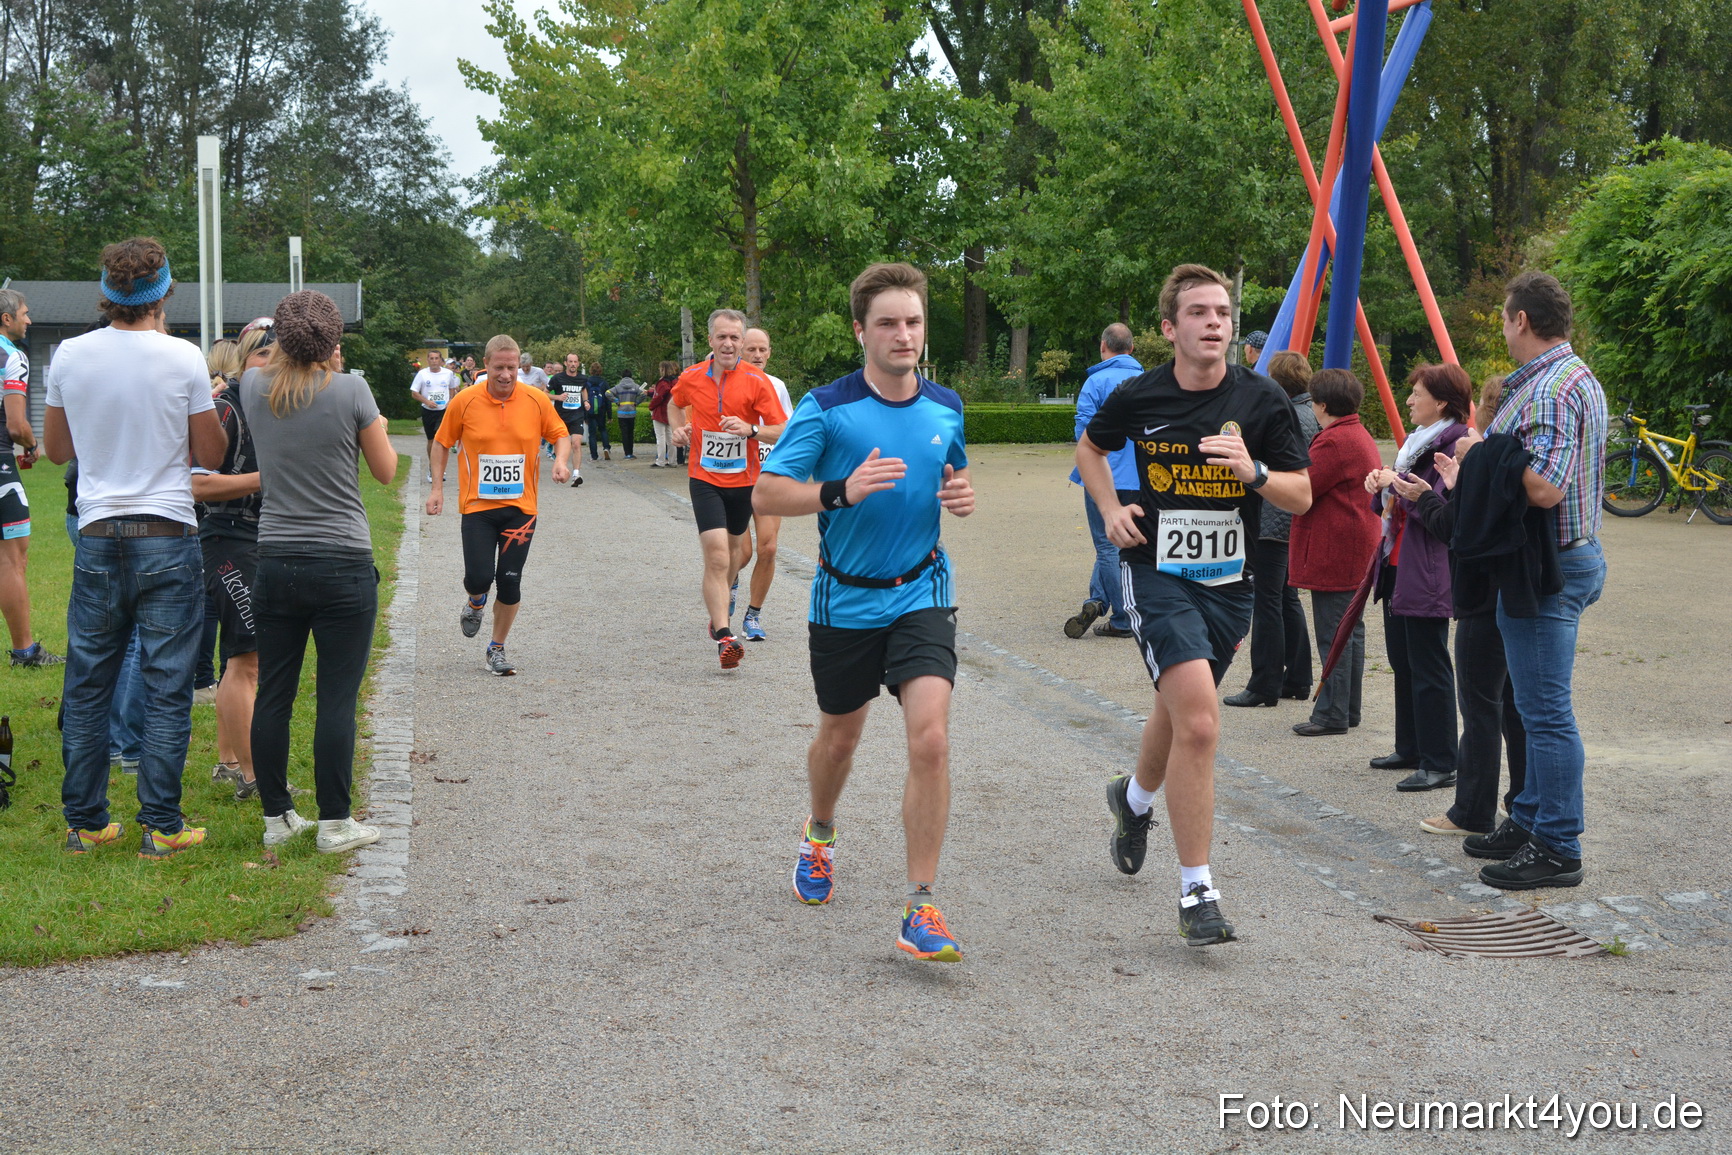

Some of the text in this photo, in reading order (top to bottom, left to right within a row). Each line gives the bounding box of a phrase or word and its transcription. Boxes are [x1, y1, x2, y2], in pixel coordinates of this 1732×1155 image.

[706, 441, 741, 457] 2271
[483, 465, 520, 482] 2055
[1171, 464, 1239, 480] FRANKL
[1175, 480, 1246, 498] MARSHALL
[1160, 518, 1233, 527] PARTL Neumarkt
[1167, 529, 1238, 559] 2910
[1181, 566, 1223, 579] Bastian
